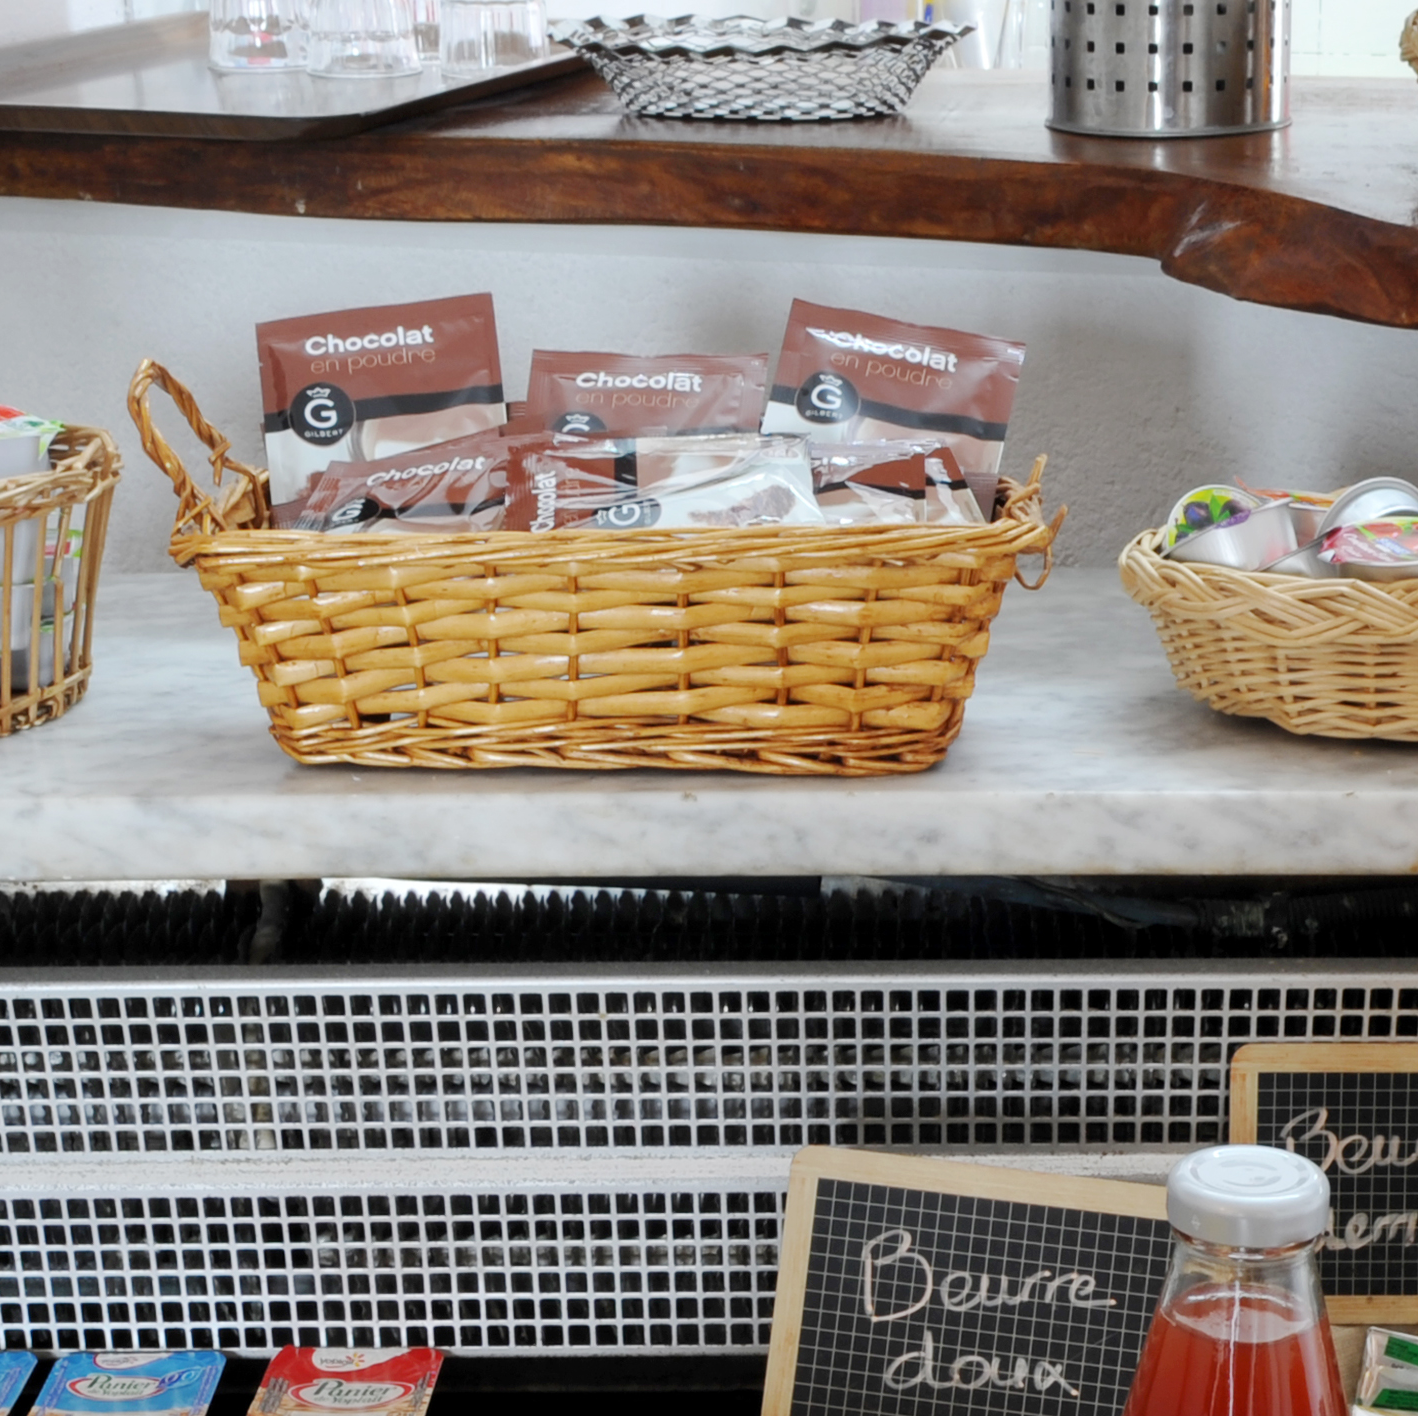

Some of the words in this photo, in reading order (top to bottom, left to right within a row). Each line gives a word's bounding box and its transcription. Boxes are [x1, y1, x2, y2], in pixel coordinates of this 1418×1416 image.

[304, 325, 435, 356] Chocolat
[310, 357, 340, 375] en
[347, 347, 437, 375] poudre
[830, 350, 860, 370] en
[865, 359, 954, 391] poudre
[575, 371, 703, 394] Chocolat
[575, 391, 605, 405] en
[611, 390, 701, 409] poudre
[804, 408, 844, 420] GILBERT
[303, 427, 345, 439] GILBERT
[366, 455, 486, 487] Chocolat
[531, 469, 557, 534] Chocolat
[861, 1228, 1119, 1323] Beurre
[884, 1331, 1081, 1396] doux
[87, 1373, 157, 1390] Panier
[313, 1379, 397, 1397] Panier
[331, 1395, 384, 1405] Yoplait
